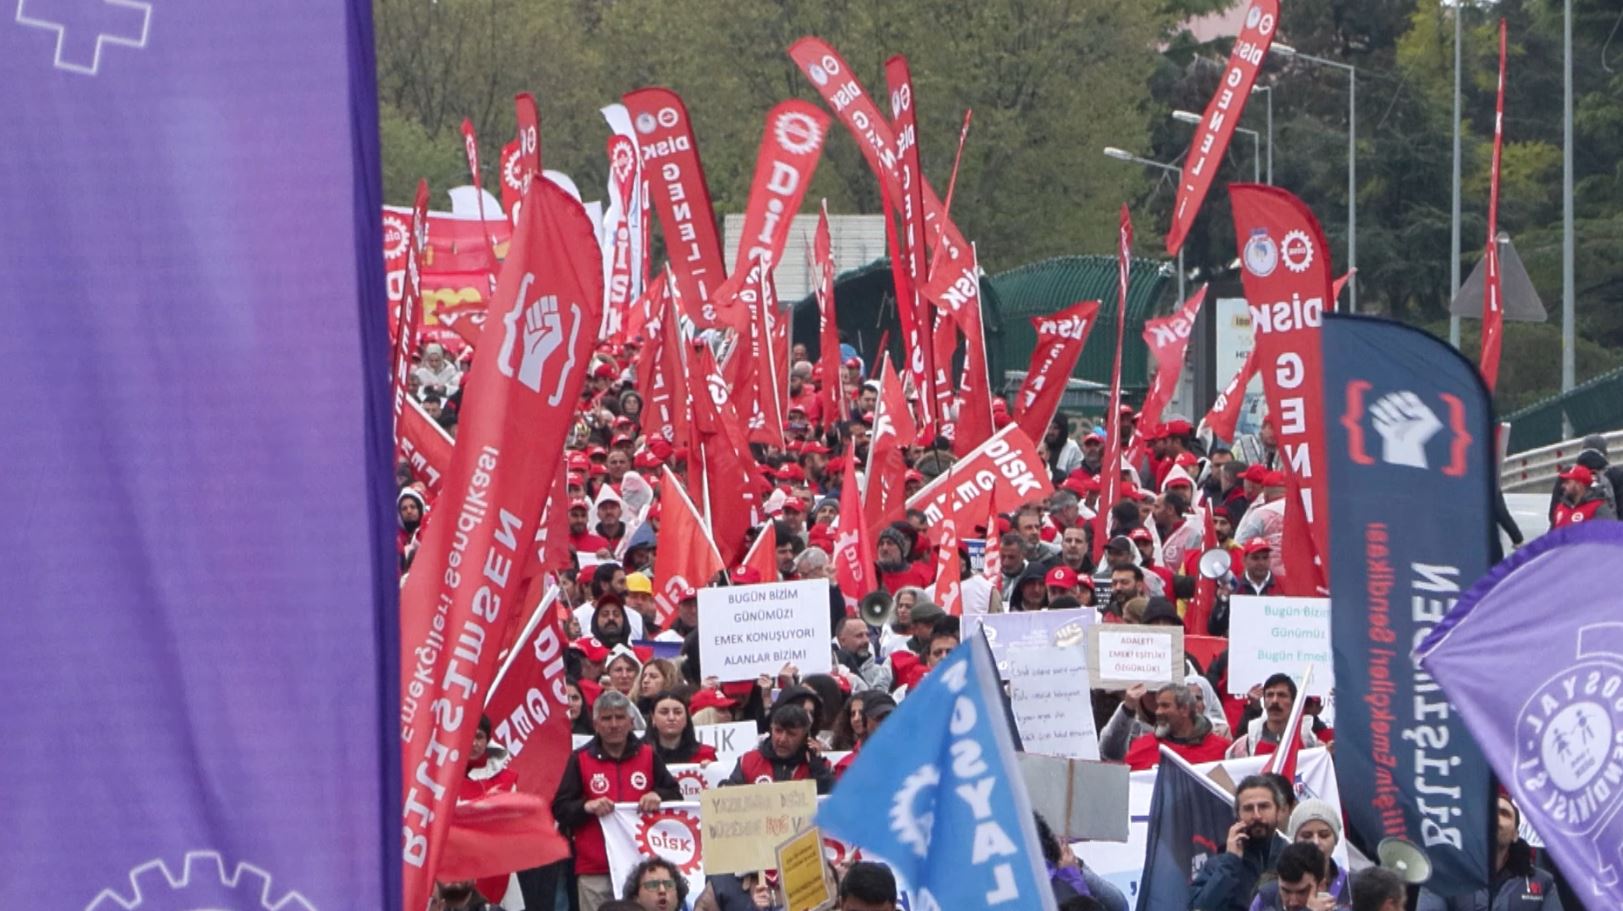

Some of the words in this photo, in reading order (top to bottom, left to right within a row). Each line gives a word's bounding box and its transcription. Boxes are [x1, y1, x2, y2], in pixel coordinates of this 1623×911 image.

[984, 438, 1042, 497] DİSK
[728, 591, 766, 604] BUGÜN
[769, 588, 798, 600] BİZİM
[1264, 605, 1300, 618] Bugün
[715, 634, 743, 646] EMEK
[746, 627, 815, 642] KONUŞUYOR!
[724, 652, 771, 666] ALANLAR
[773, 648, 807, 661] BİZİM!
[1257, 649, 1293, 663] Bugün
[651, 831, 692, 852] DİSK
